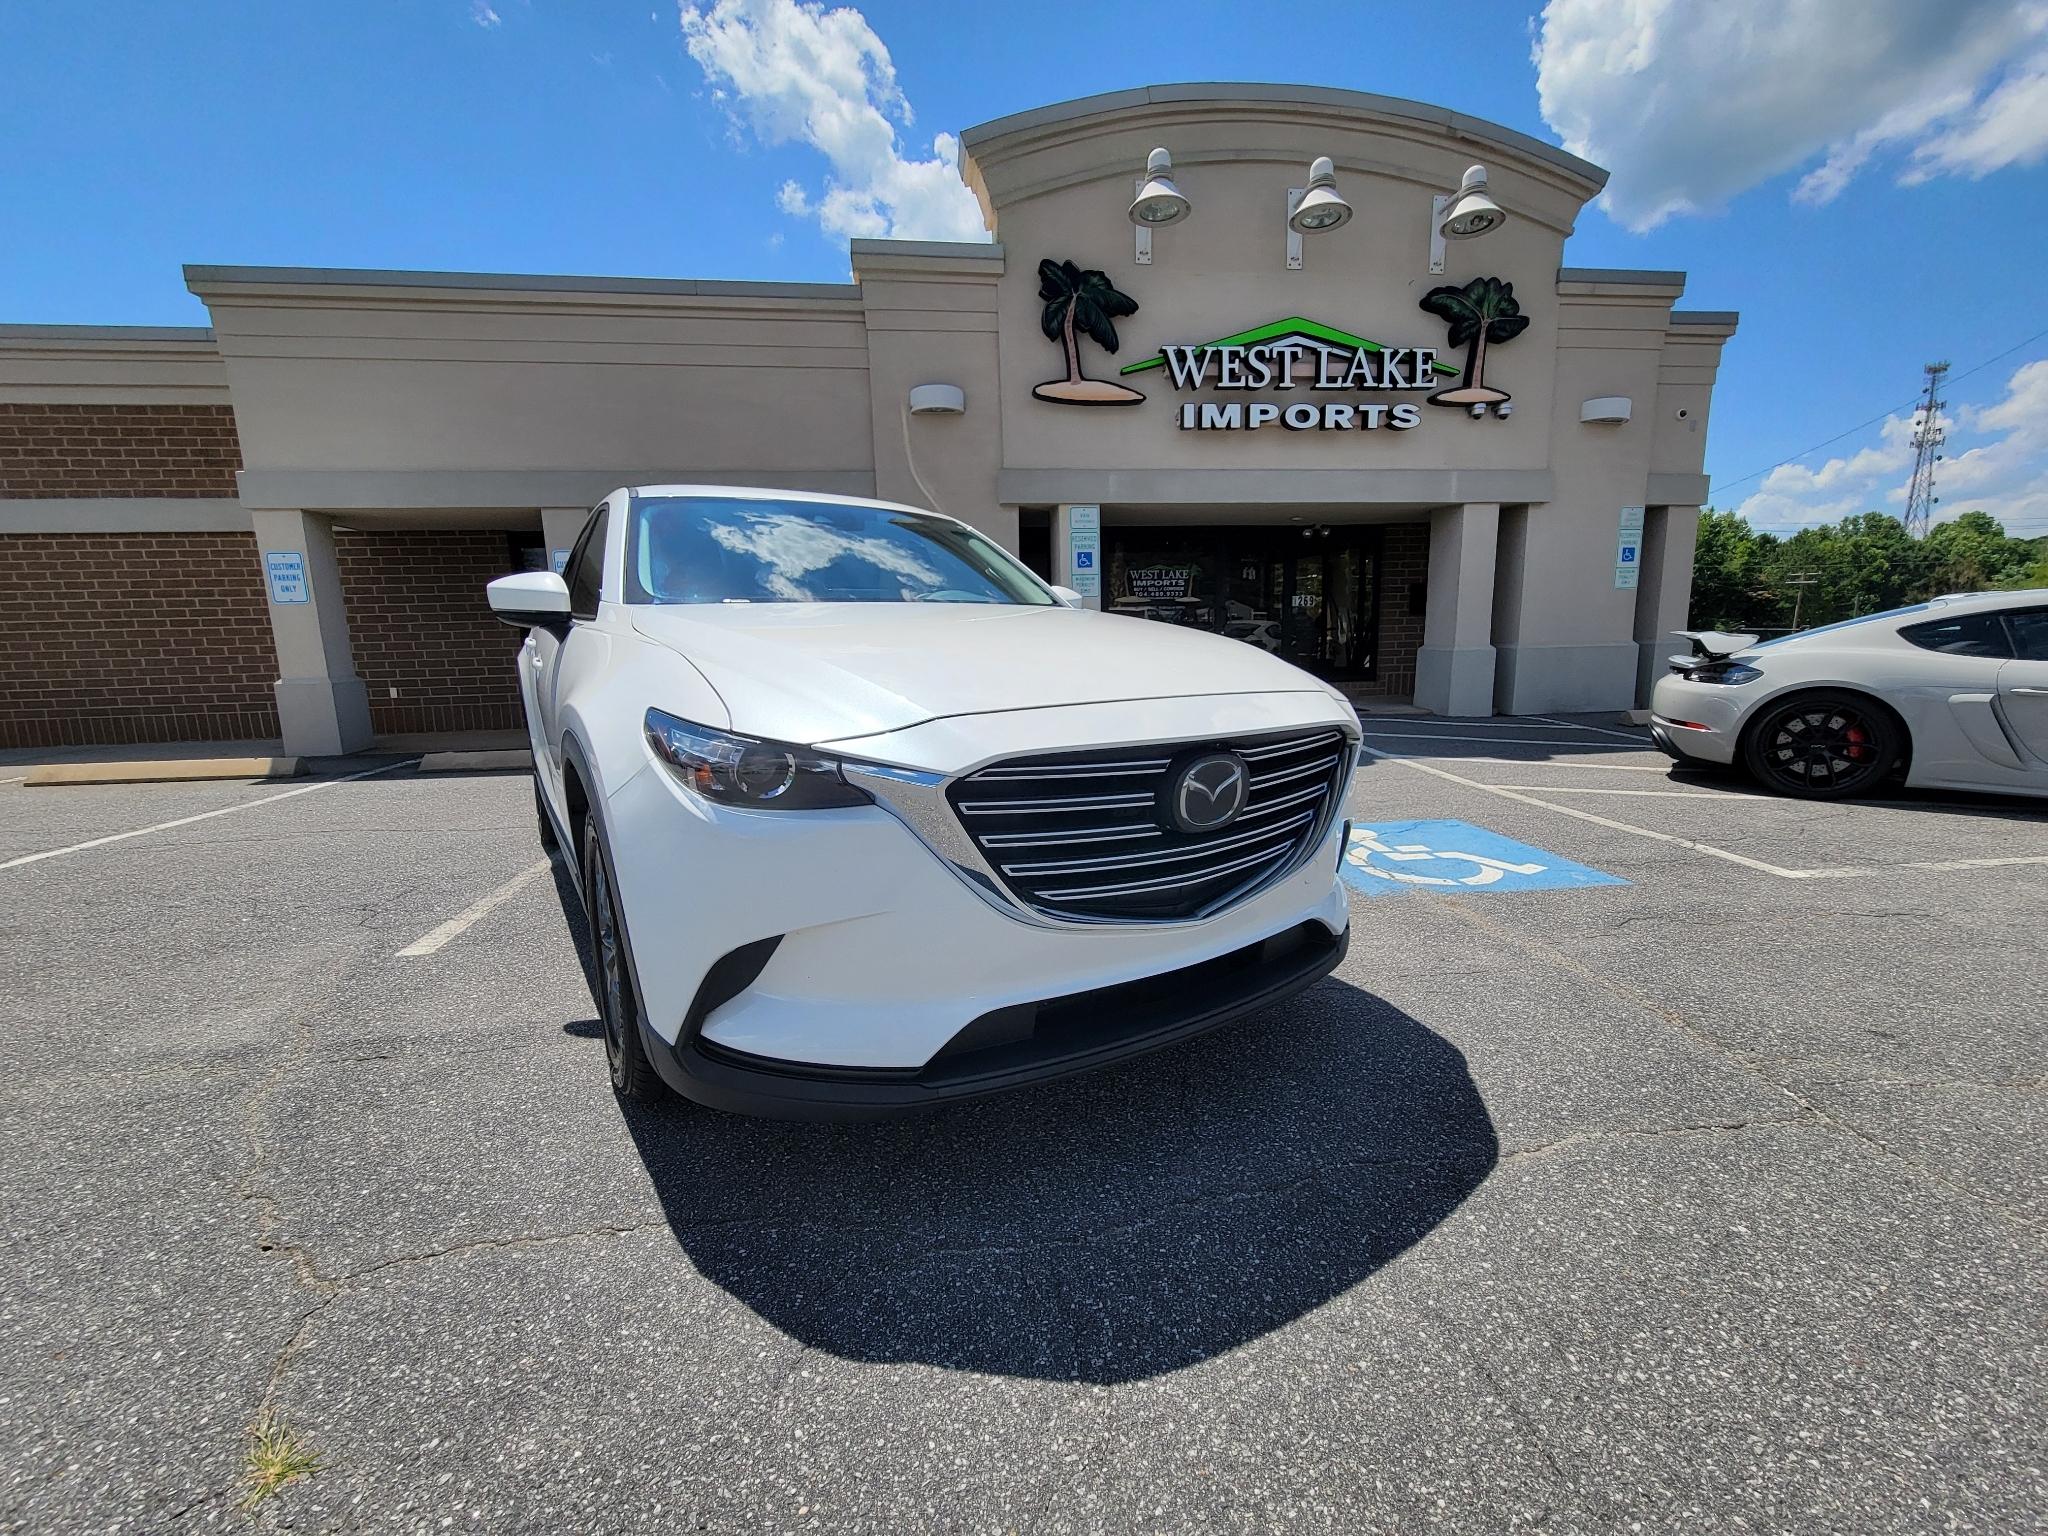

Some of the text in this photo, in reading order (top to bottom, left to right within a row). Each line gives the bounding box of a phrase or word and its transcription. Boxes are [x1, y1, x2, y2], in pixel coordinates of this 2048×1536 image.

[1161, 345, 1439, 390] WEST LAKE
[1181, 402, 1422, 431] IMPORTS
[270, 562, 301, 571] CUSTOMER
[273, 574, 301, 582] PARKING
[1130, 569, 1189, 579] WEST LAKE
[1133, 579, 1185, 587] IMPORTS
[281, 585, 297, 593] ONLY
